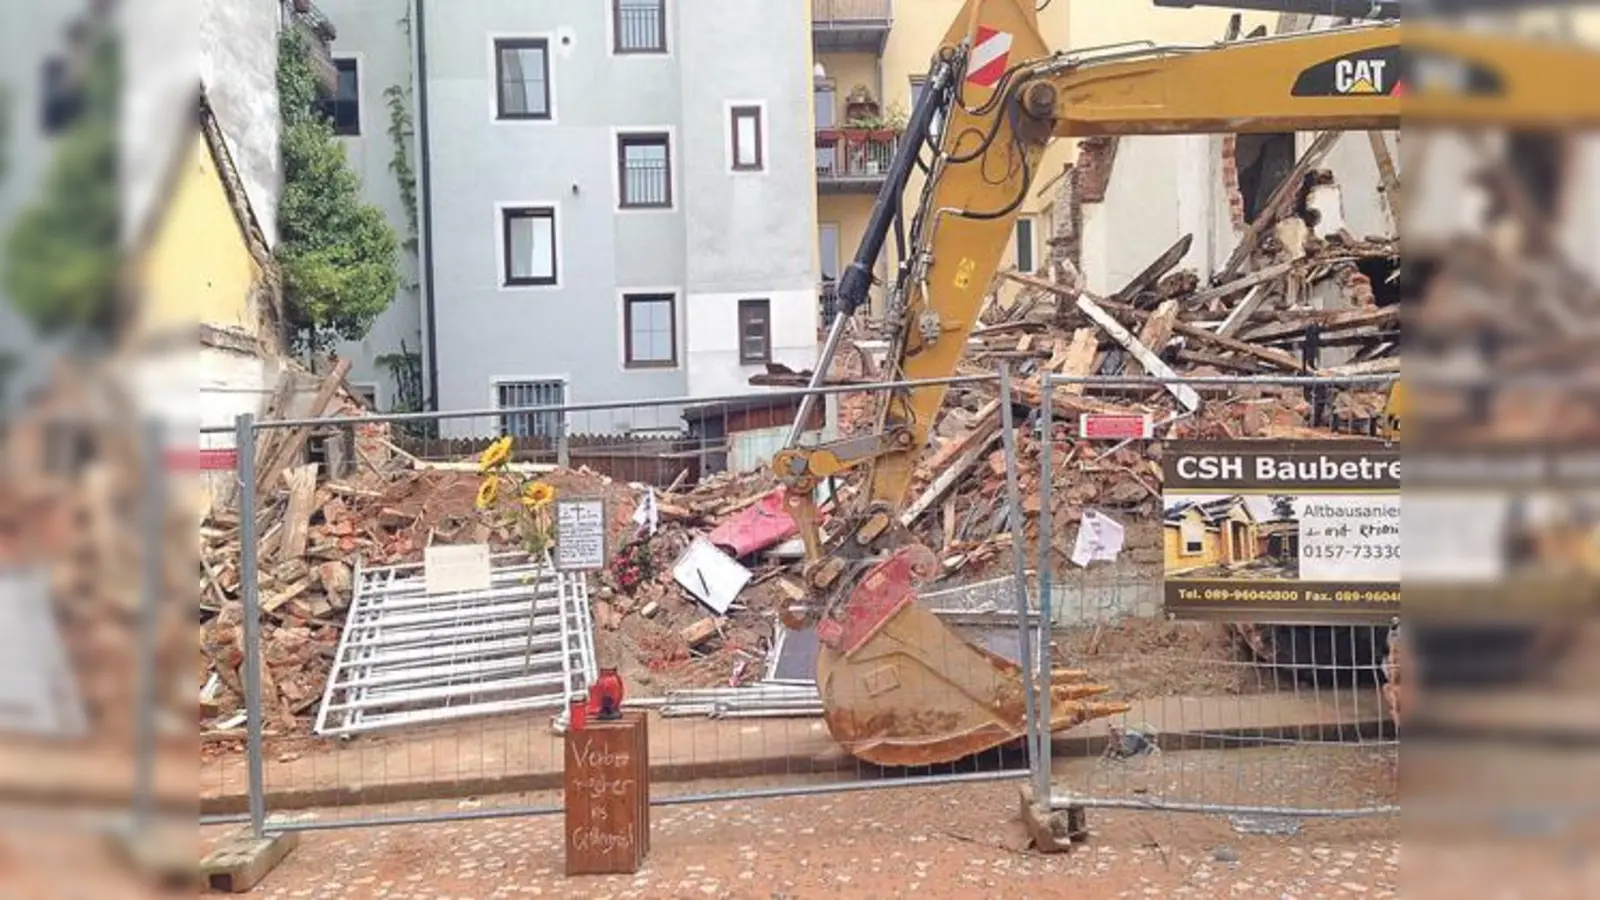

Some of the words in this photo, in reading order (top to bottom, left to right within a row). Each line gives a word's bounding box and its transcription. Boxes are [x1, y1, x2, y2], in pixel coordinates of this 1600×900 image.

[1335, 59, 1386, 93] CAT
[1176, 456, 1244, 480] CSH
[1255, 456, 1400, 480] Baubetre
[1178, 588, 1202, 600] Tel.
[1304, 590, 1333, 602] Fax.
